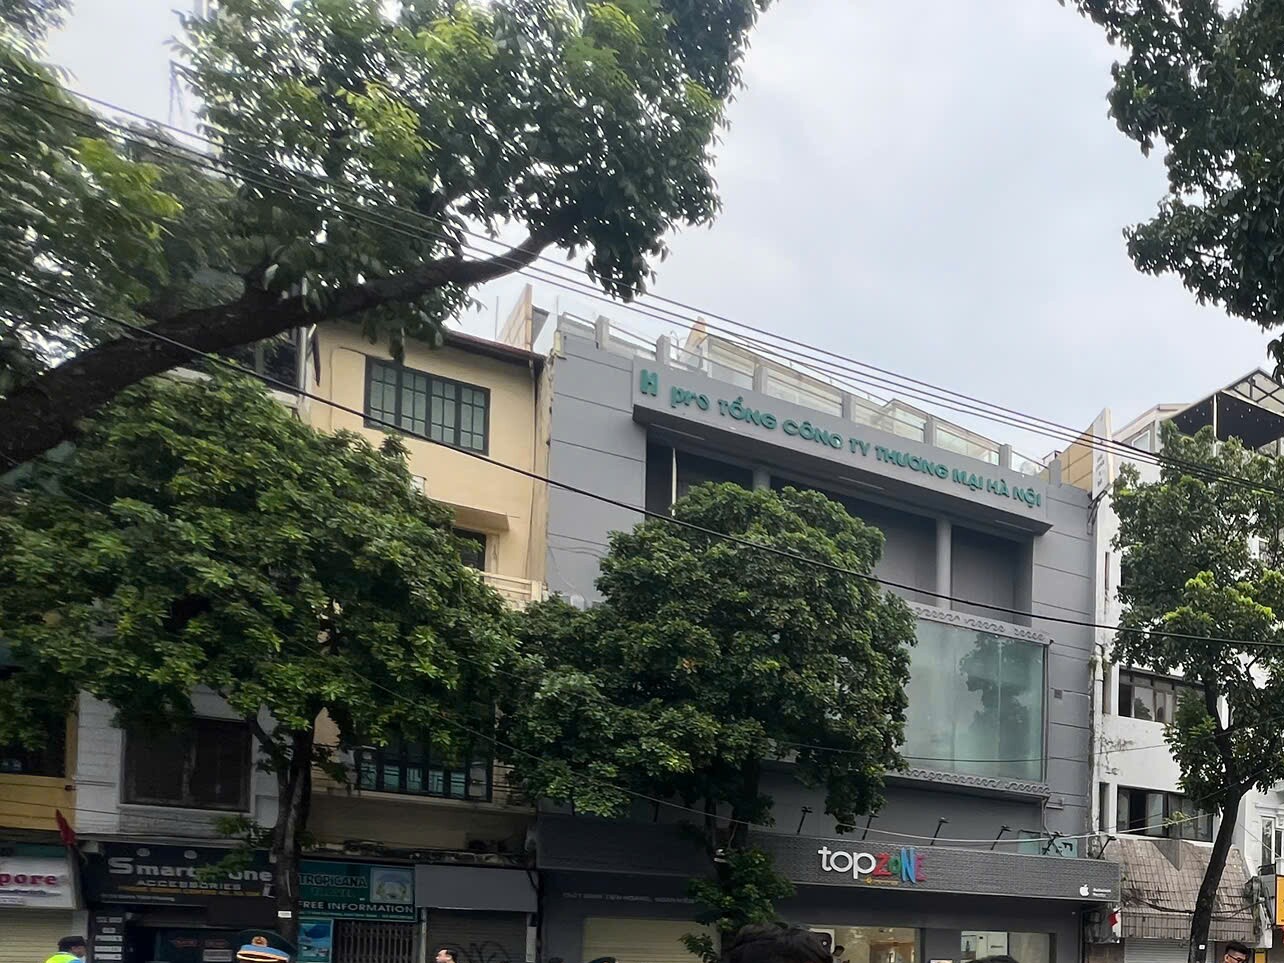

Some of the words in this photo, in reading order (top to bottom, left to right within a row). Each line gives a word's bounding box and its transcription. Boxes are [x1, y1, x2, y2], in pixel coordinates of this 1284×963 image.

[671, 386, 709, 409] pro
[717, 396, 778, 429] TỔNG
[782, 421, 843, 449] CÔNG
[849, 438, 871, 456] TY
[875, 445, 949, 479] THƯƠNG
[952, 469, 983, 491] MẠI
[987, 478, 1010, 497] HÀ
[1012, 487, 1041, 508] NỘI
[298, 872, 368, 888] TROPICANA
[328, 902, 414, 913] INFORMATION
